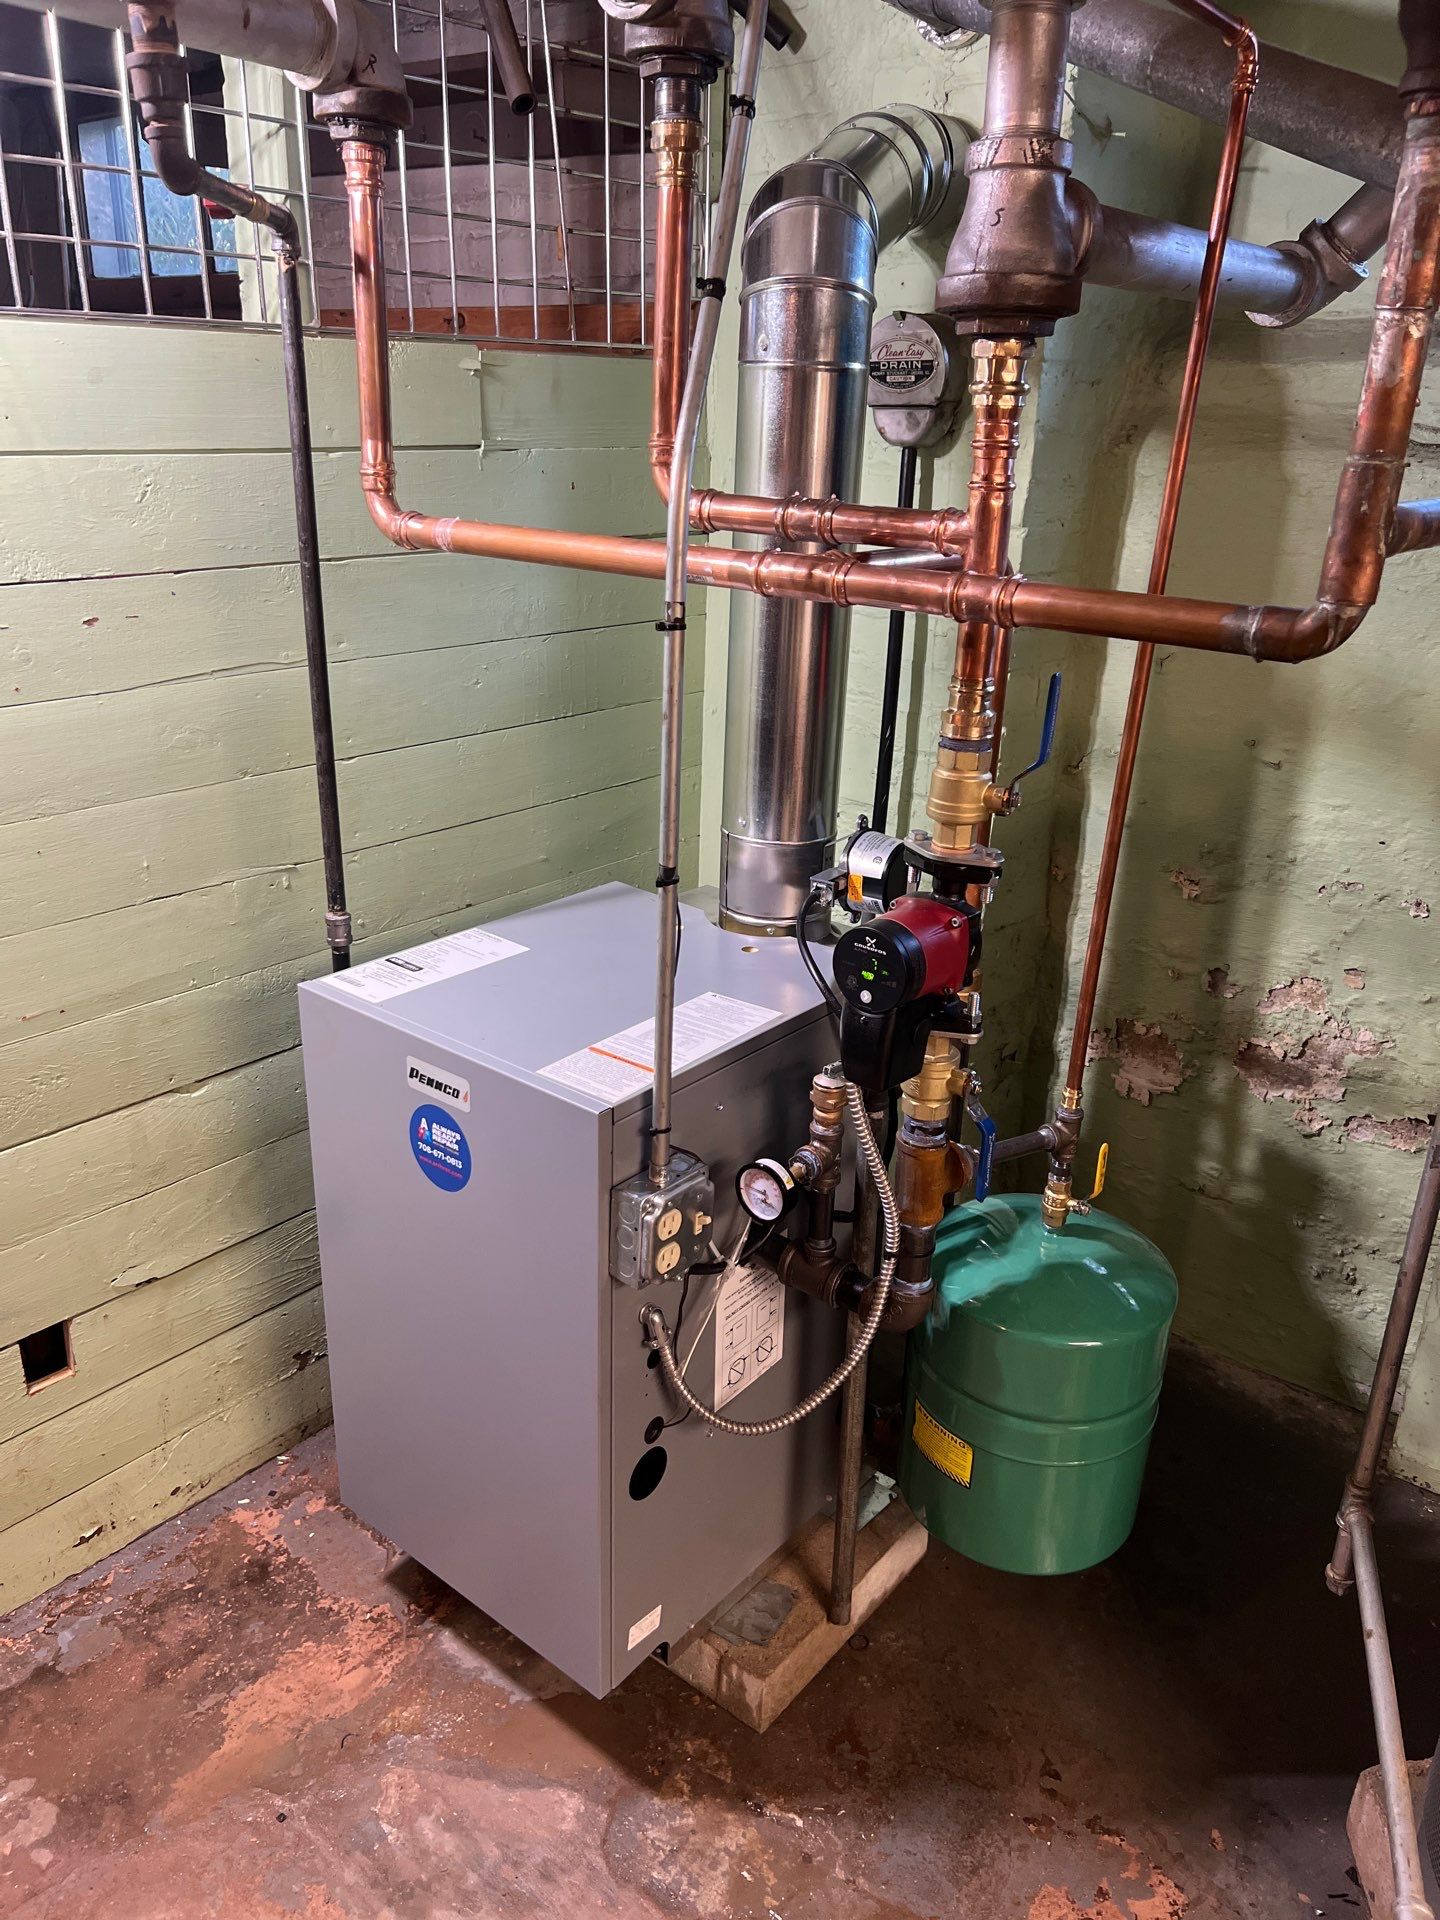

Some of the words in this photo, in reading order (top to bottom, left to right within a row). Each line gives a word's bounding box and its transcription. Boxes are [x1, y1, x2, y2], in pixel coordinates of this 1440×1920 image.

[880, 360, 922, 370] DRAIN
[409, 1067, 460, 1099] PENNCO
[922, 1412, 967, 1450] WARNING
